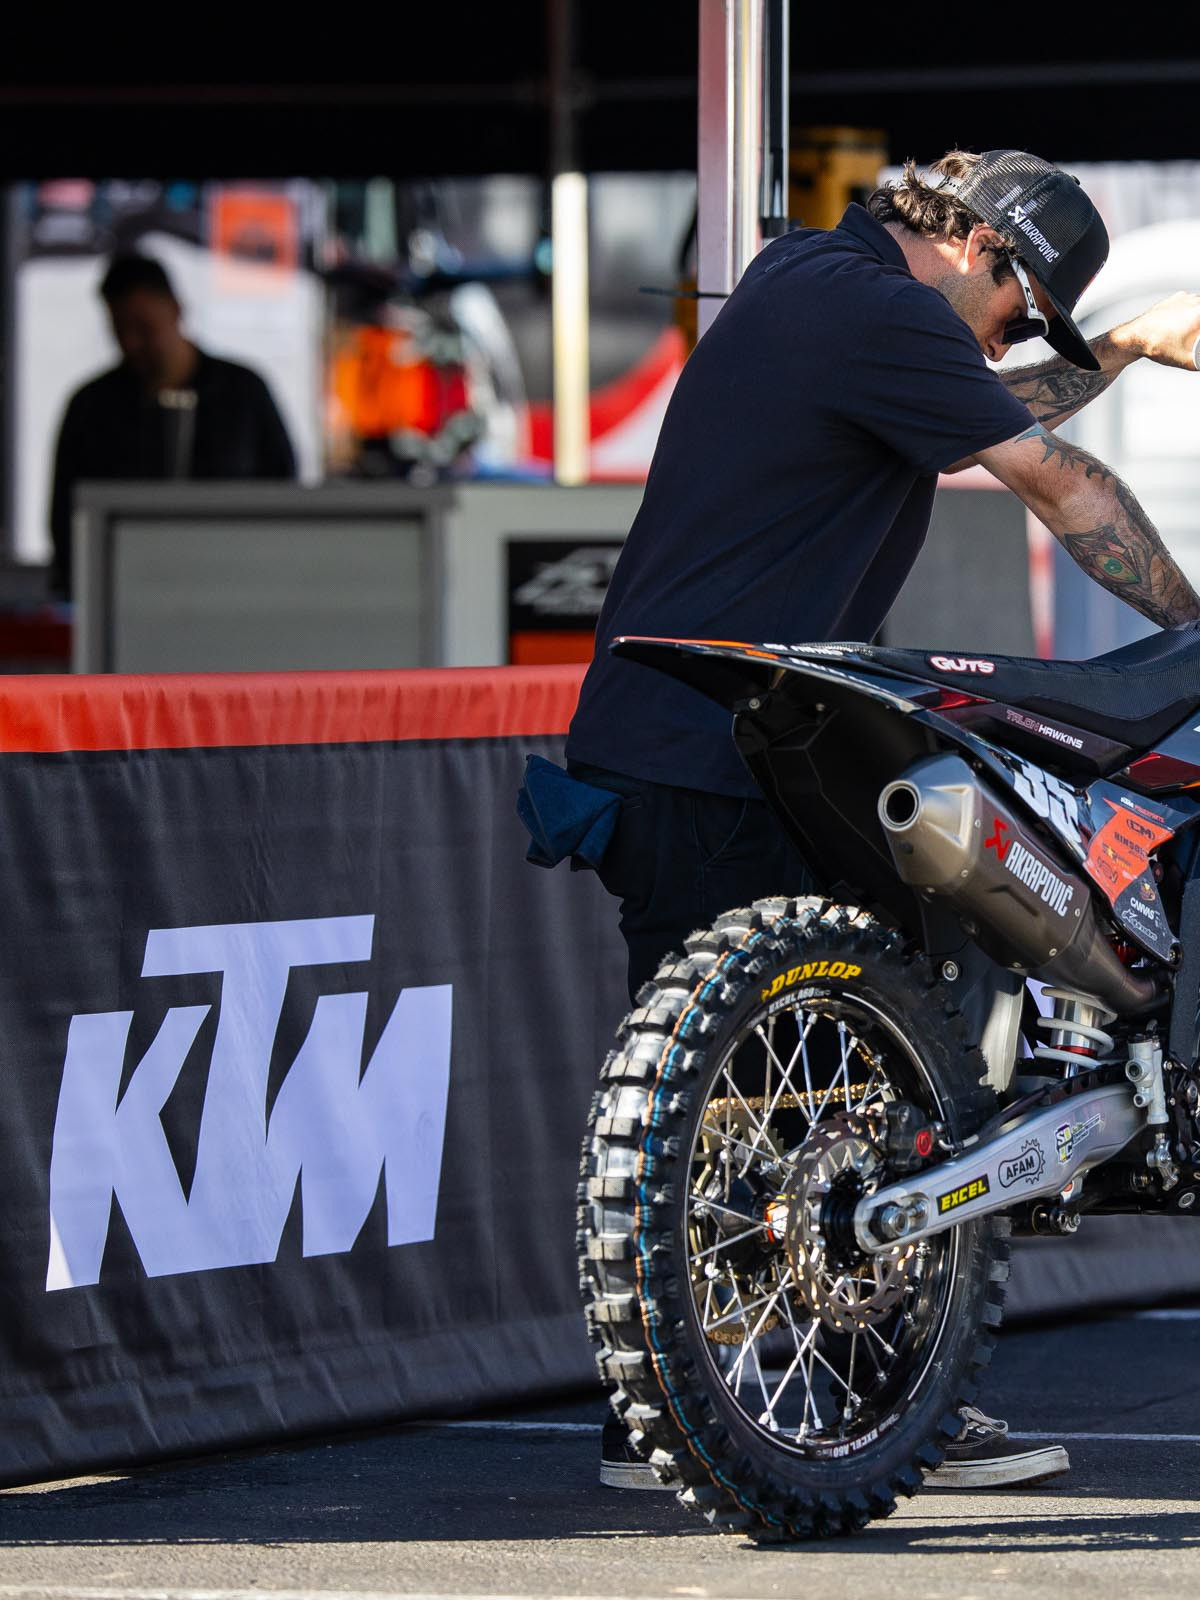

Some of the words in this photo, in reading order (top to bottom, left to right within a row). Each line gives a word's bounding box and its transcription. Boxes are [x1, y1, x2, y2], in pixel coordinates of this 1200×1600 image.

[930, 655, 996, 675] GUTS
[1006, 709, 1039, 731] TALON
[1039, 724, 1084, 750] HAWKINS
[769, 960, 863, 997] DUNLOP
[45, 914, 454, 1292] KTM
[1006, 1155, 1035, 1180] AFAM
[940, 1179, 988, 1212] EXCEL
